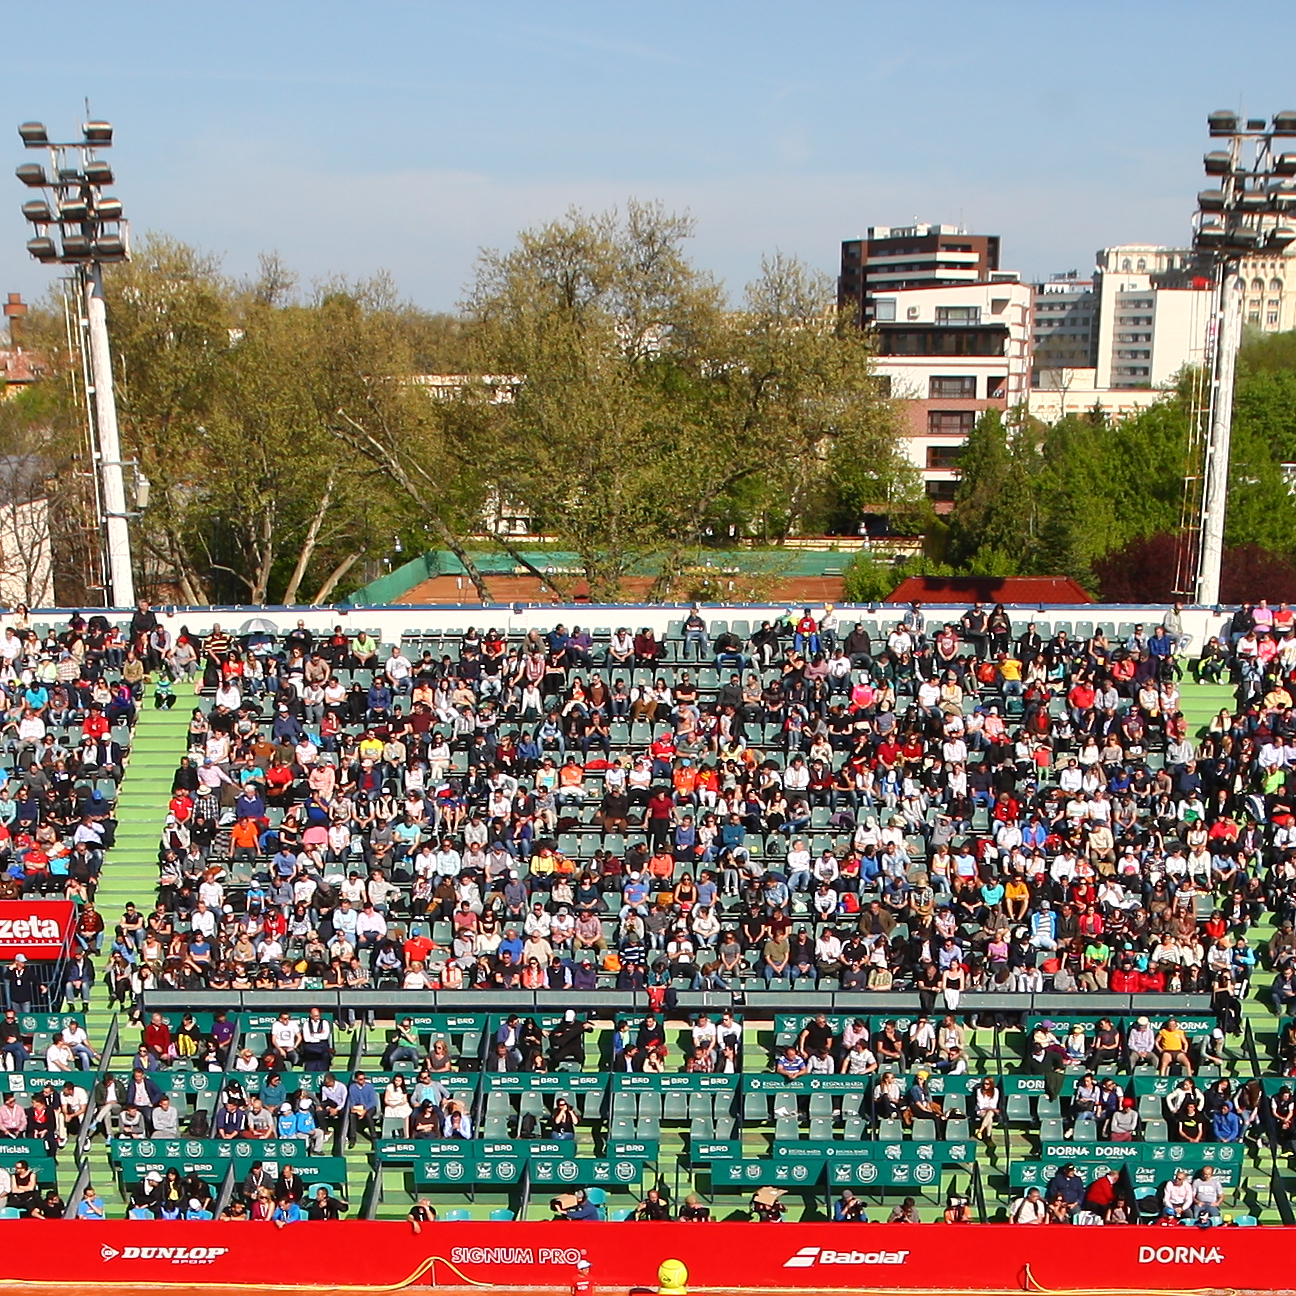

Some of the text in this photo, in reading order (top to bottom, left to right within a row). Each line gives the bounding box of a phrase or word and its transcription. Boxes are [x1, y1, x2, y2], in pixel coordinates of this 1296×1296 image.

[1047, 1147, 1137, 1156] DORNA DORNA
[121, 1246, 225, 1260] DUNLOP
[451, 1247, 581, 1265] SIGNUM PRO
[1138, 1246, 1224, 1263] DORNA
